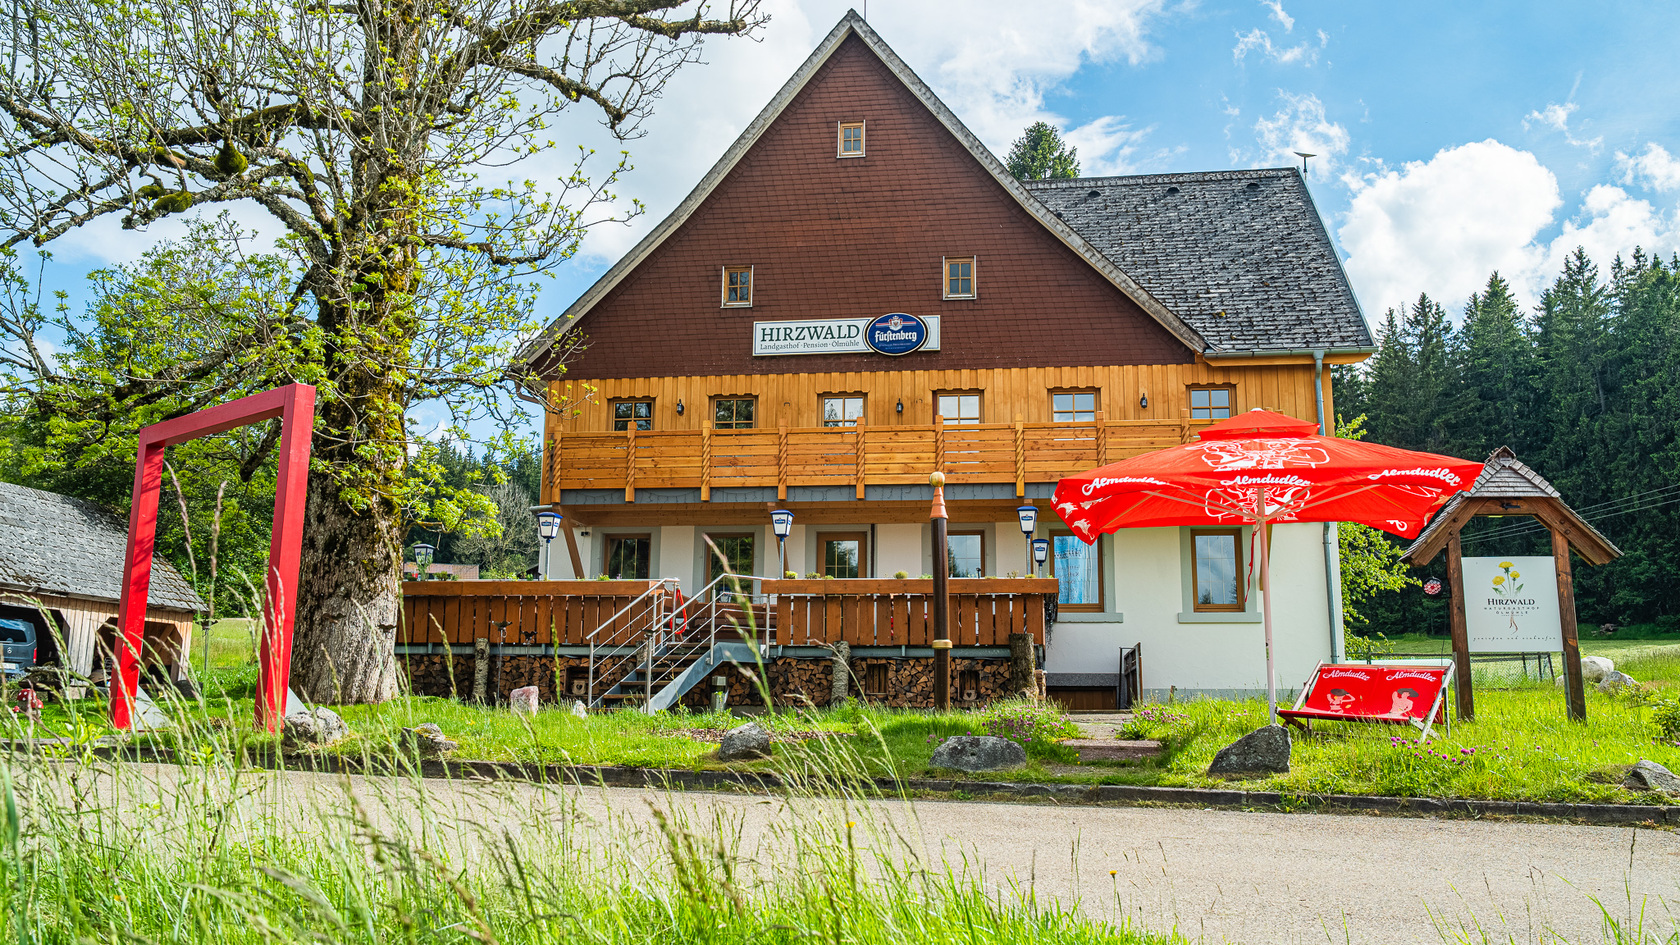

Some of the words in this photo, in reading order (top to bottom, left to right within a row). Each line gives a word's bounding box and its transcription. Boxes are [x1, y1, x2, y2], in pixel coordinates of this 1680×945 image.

[761, 324, 860, 342] HIRZWALD
[875, 330, 918, 343] Fürstenberg
[760, 342, 800, 351] Landgasthof
[803, 341, 829, 349] Pension
[1220, 473, 1312, 486] Almdudler
[1367, 467, 1461, 486] Almdudler
[1487, 598, 1536, 606] HIRZWALD
[1322, 669, 1371, 681] Almdudler
[1386, 671, 1437, 682] Almdudler
